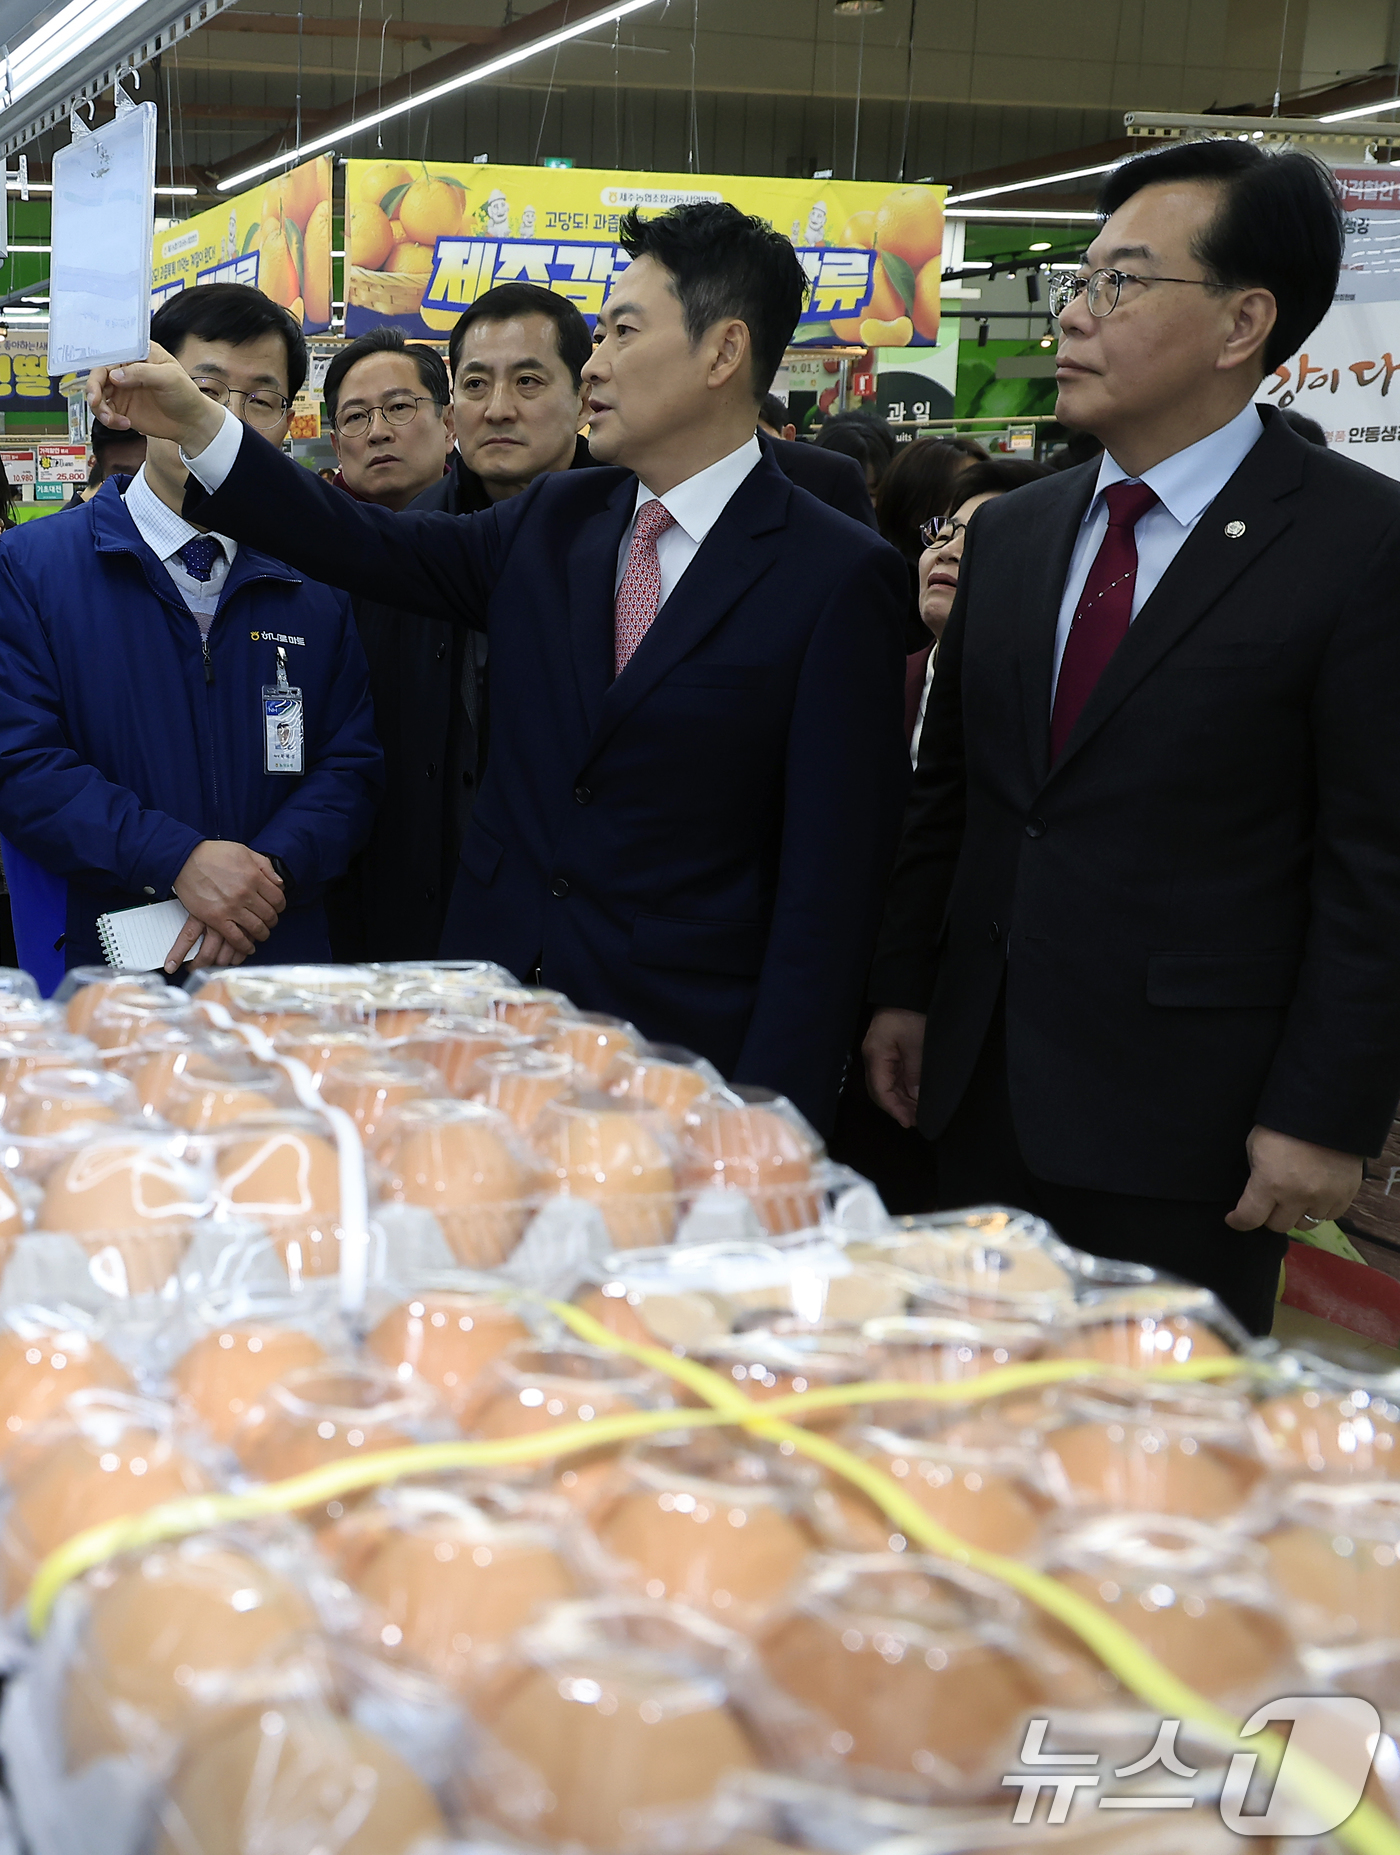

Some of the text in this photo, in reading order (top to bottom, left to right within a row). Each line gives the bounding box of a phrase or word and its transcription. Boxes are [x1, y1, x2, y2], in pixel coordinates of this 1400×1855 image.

[545, 211, 589, 231] 고당도!
[801, 251, 871, 313] 류
[887, 400, 931, 422] 과일
[895, 432, 913, 443] uits
[1348, 425, 1400, 443] 안동생
[13, 474, 34, 483] 10,980
[56, 472, 85, 482] 25,800
